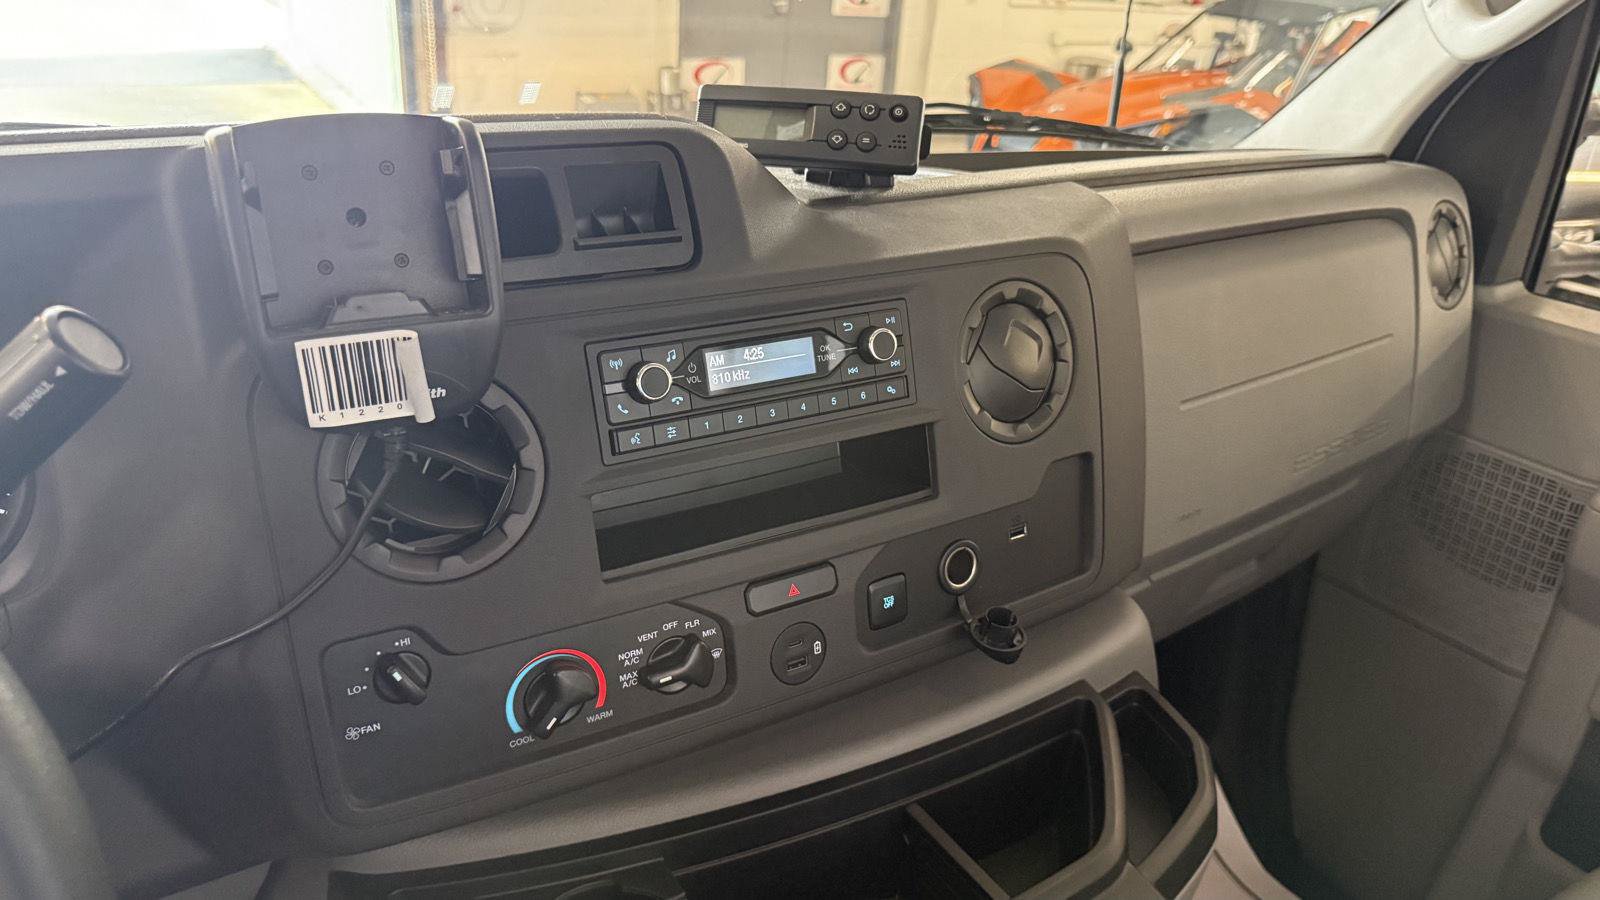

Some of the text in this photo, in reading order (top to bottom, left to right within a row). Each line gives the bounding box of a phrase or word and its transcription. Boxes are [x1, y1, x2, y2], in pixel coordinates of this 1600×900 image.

[709, 355, 725, 367] AM
[817, 353, 836, 362] TUNE
[686, 376, 701, 384] VOL
[732, 369, 750, 382] kHz
[705, 391, 866, 429] 1 2 3 4 5 6
[663, 621, 678, 631] OFF
[685, 619, 700, 629] FLR
[637, 631, 658, 643] VENT
[702, 628, 717, 637] MIX
[400, 637, 411, 647] HI
[618, 648, 644, 661] NORM
[624, 656, 640, 667] A/C
[619, 671, 638, 682] MAX
[622, 678, 638, 689] A/C
[347, 685, 362, 695] LO
[586, 709, 614, 724] WARM
[361, 723, 381, 735] FAN
[509, 735, 536, 749] COOL
